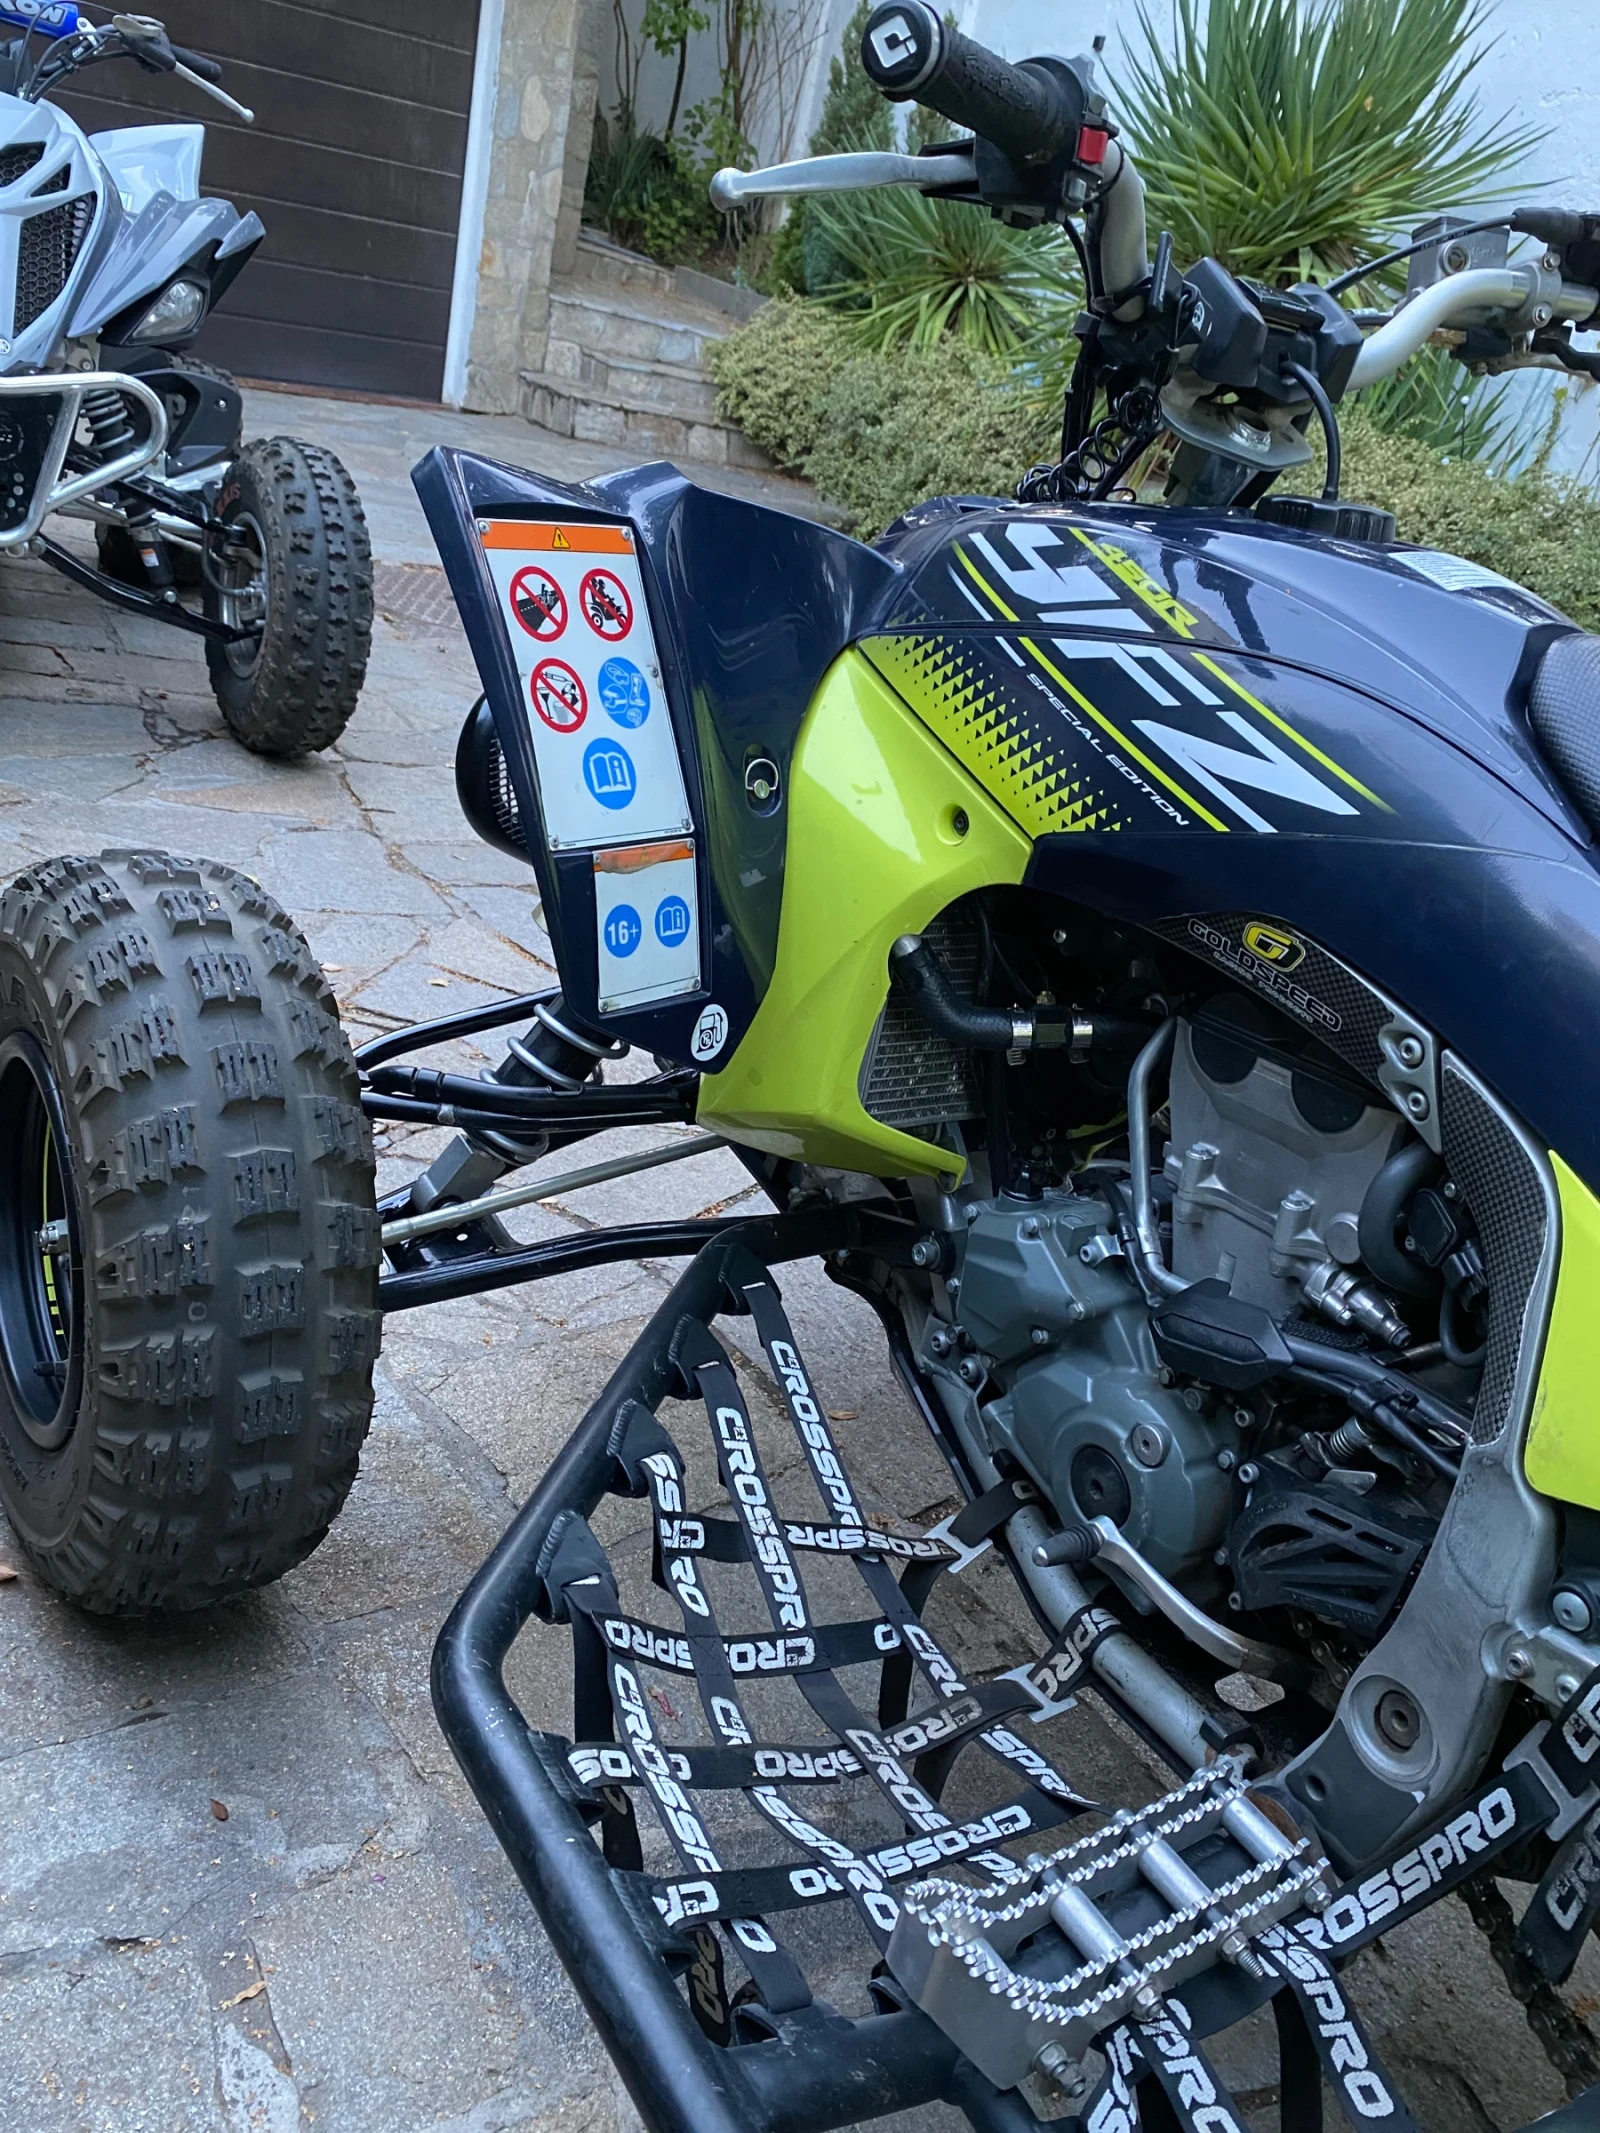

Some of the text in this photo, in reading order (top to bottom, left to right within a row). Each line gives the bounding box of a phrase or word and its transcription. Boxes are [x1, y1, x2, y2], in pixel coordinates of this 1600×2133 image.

[1026, 672, 1189, 827] SPECIAL EDITION
[607, 920, 639, 946] 16+
[1188, 919, 1342, 1032] GOLDSPEED
[1213, 951, 1314, 1023] RACING PRODUCTS
[716, 1407, 807, 1631] CROSSPR
[771, 1340, 879, 1563] CROSSPR
[1294, 1787, 1516, 1950] ROSSPRO
